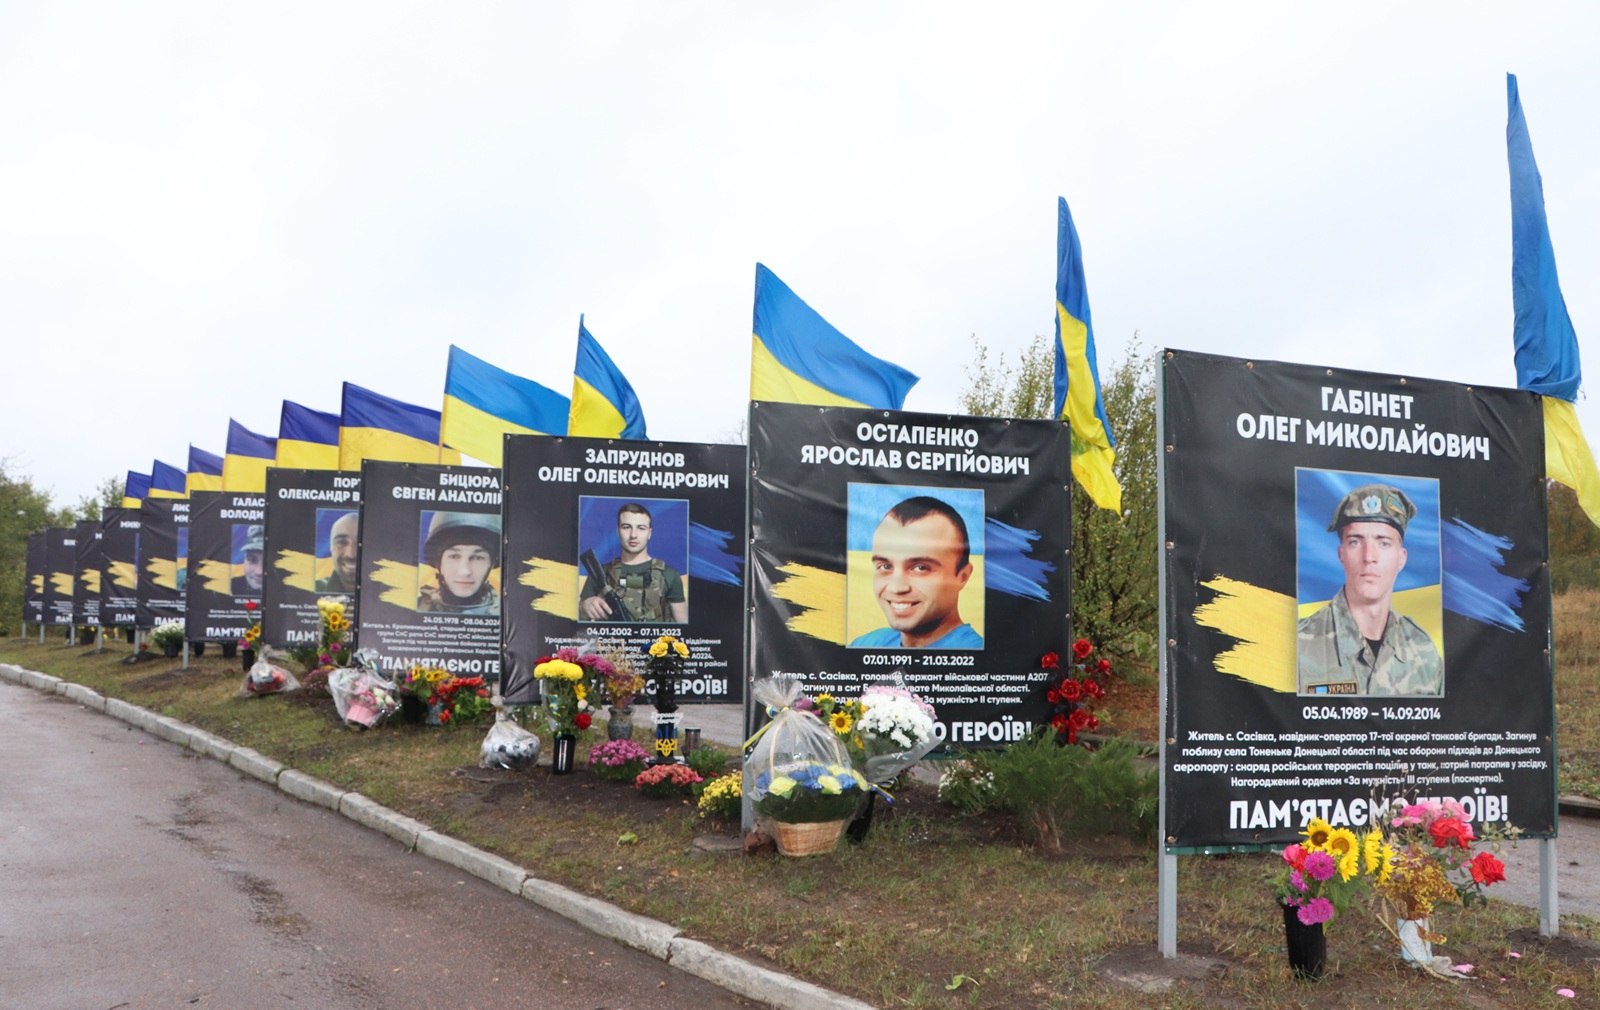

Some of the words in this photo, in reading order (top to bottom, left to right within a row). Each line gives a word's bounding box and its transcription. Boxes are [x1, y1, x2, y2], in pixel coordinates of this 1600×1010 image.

[1321, 386, 1414, 420] ГАБІНЕТ
[856, 422, 979, 448] ОСТАПЕНКО
[1236, 412, 1301, 443] ОЛЕГ
[1306, 419, 1490, 461] МИКОЛАЙОВИЧ
[585, 448, 685, 469] ЗАПРУДНОВ
[801, 445, 902, 469] ЯРОСЛАВ
[906, 449, 1030, 475] СЕРГІЙОВИЧ
[334, 477, 361, 489] ПОР
[439, 473, 500, 489] БИЦЮРА
[538, 466, 581, 483] ОЛЕГ
[584, 468, 729, 489] ОЛЕКСАНДРОВИЧ
[278, 488, 351, 503] ОЛЕКСАНДР
[392, 486, 436, 501] ЄВГЕН
[233, 497, 265, 508] ГАЛАС
[220, 509, 264, 521] ВОЛОДИ
[423, 616, 459, 625] 24.05.1978
[206, 627, 247, 638] ПАМ’ЯТ
[587, 627, 632, 637] 04.01.2002
[640, 628, 681, 637] 07.11.2023
[628, 638, 651, 646] номер
[685, 638, 721, 646] відділення
[691, 652, 714, 660] А0224.
[863, 655, 912, 665] 07.01.1991
[922, 656, 974, 666] 21.03.2022
[383, 656, 482, 673] ПАМ’ЯТАЄМО
[704, 660, 728, 669] районі
[668, 674, 728, 695] ЕРОЇВ!
[819, 671, 859, 682] Сасівка,
[904, 674, 943, 683] сержант
[944, 673, 989, 682] військової
[990, 674, 1026, 682] частини
[1027, 673, 1049, 682] А207
[800, 684, 835, 693] Загинув
[932, 683, 994, 693] Миколаївської
[995, 683, 1031, 693] області.
[936, 695, 978, 705] мужність»
[986, 696, 1023, 705] ступеня.
[1302, 706, 1368, 720] 05.04.1989
[1382, 707, 1441, 721] 14.09.2014
[951, 715, 1032, 742] ГЕРОЇВ!
[1188, 731, 1224, 741] Житель
[1236, 731, 1276, 742] Сасівка,
[1279, 731, 1367, 743] навідник-оператор
[1369, 732, 1394, 742] 17-тої
[1395, 732, 1430, 743] окремої
[1431, 731, 1466, 742] танкової
[1468, 732, 1504, 742] бригади.
[1505, 731, 1537, 742] Загинув
[1182, 747, 1222, 758] поблизу
[1224, 749, 1247, 757] села
[1249, 747, 1292, 756] Тоненьке
[1294, 746, 1340, 757] Донецької
[1342, 746, 1376, 756] області
[1377, 746, 1391, 757] під
[1392, 748, 1408, 756] час
[1409, 747, 1446, 757] оборони
[1447, 746, 1482, 756] підходів
[1483, 747, 1493, 756] до
[1494, 746, 1541, 756] Донецького
[1173, 764, 1229, 775] аеропорту
[1235, 763, 1270, 774] снаряд
[1272, 762, 1322, 773] російських
[1324, 762, 1374, 772] терористів
[1375, 762, 1408, 772] поцілив
[1410, 763, 1416, 771] у
[1417, 762, 1439, 771] танк,
[1471, 761, 1510, 771] потрапив
[1511, 762, 1517, 771] у
[1518, 759, 1548, 770] засідку.
[1231, 777, 1300, 789] Нагороджений
[1302, 778, 1341, 787] орденом
[1344, 777, 1360, 785] «За
[1362, 776, 1405, 786] мужність»
[1416, 776, 1450, 785] ступеня
[1451, 773, 1504, 784] (посмертно).
[1416, 787, 1508, 824] ОЇВ!
